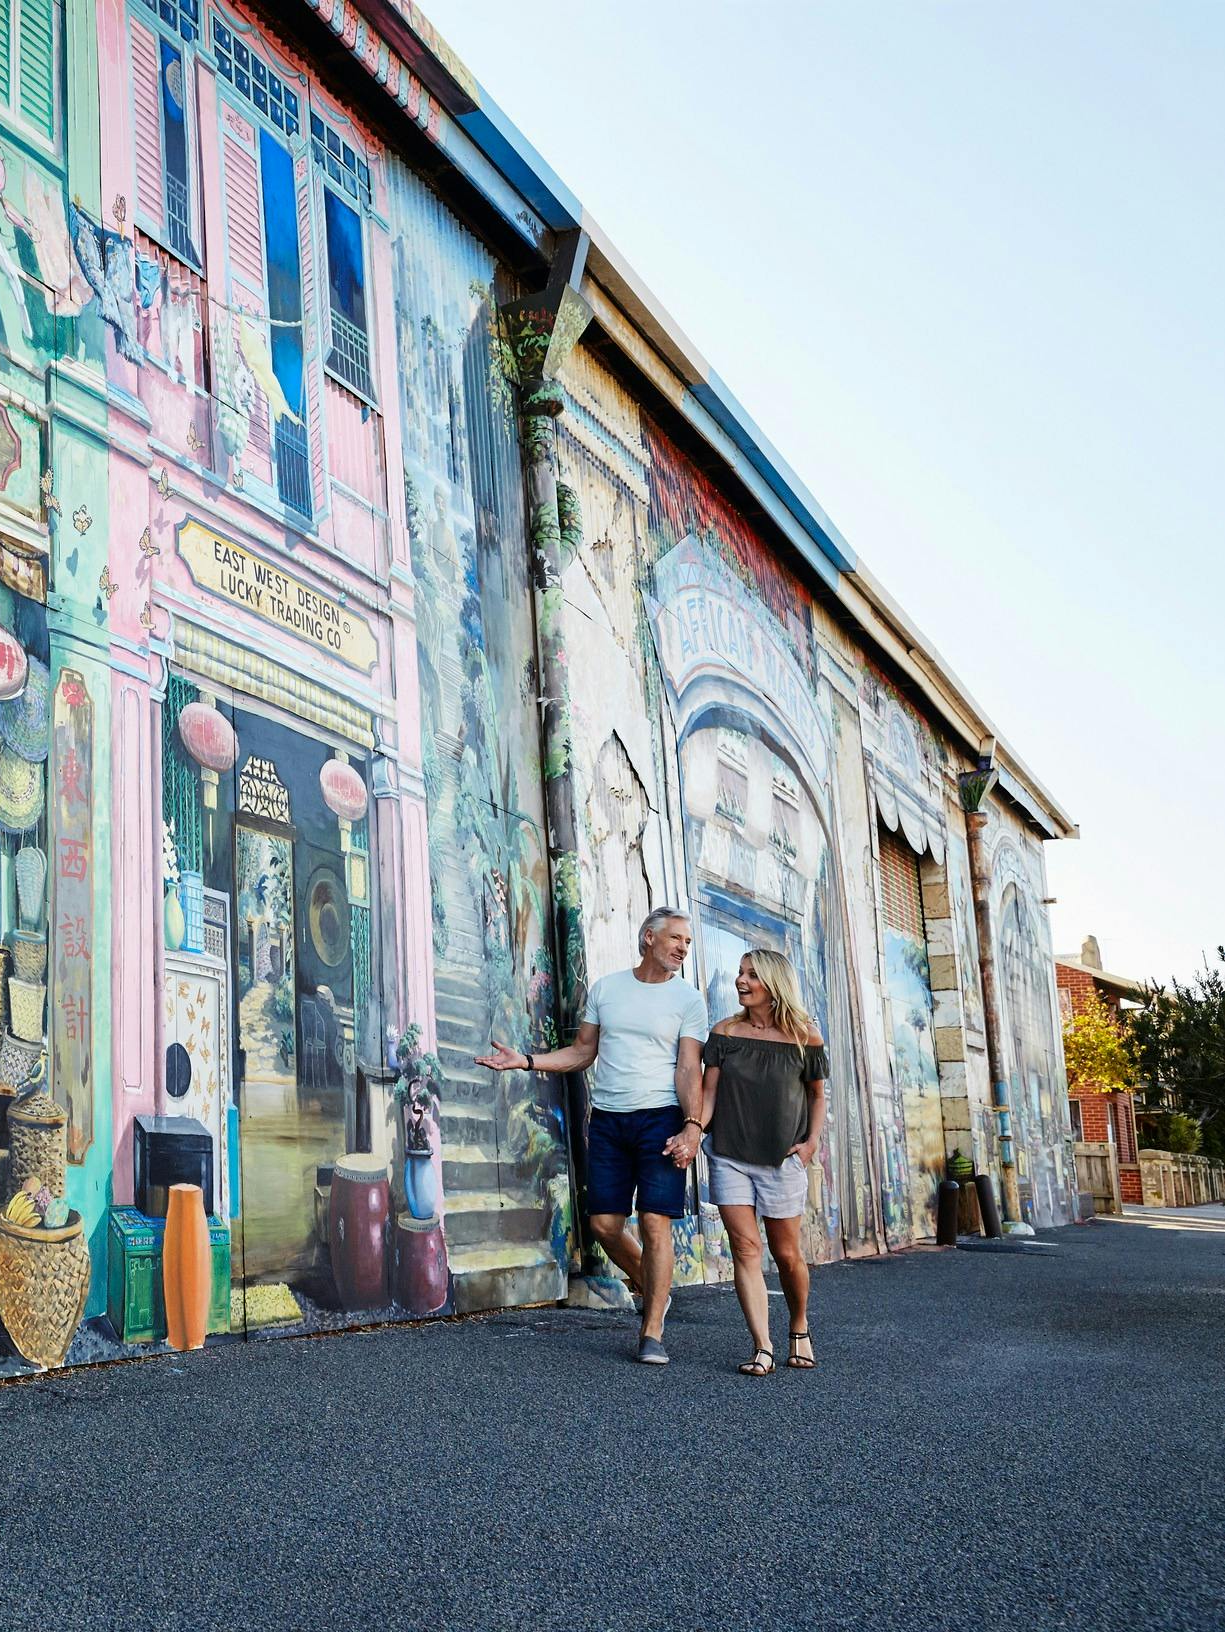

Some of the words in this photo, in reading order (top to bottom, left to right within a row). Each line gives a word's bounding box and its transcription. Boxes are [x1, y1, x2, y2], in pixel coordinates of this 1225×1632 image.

[214, 540, 246, 575] EAST
[253, 562, 289, 599] WEST
[297, 587, 341, 627] DESIGN
[220, 569, 263, 608] LUCKY
[270, 595, 324, 641] TRADING
[327, 627, 342, 650] CO
[677, 597, 753, 671] AFRICAN
[58, 747, 92, 1044] 東西設計
